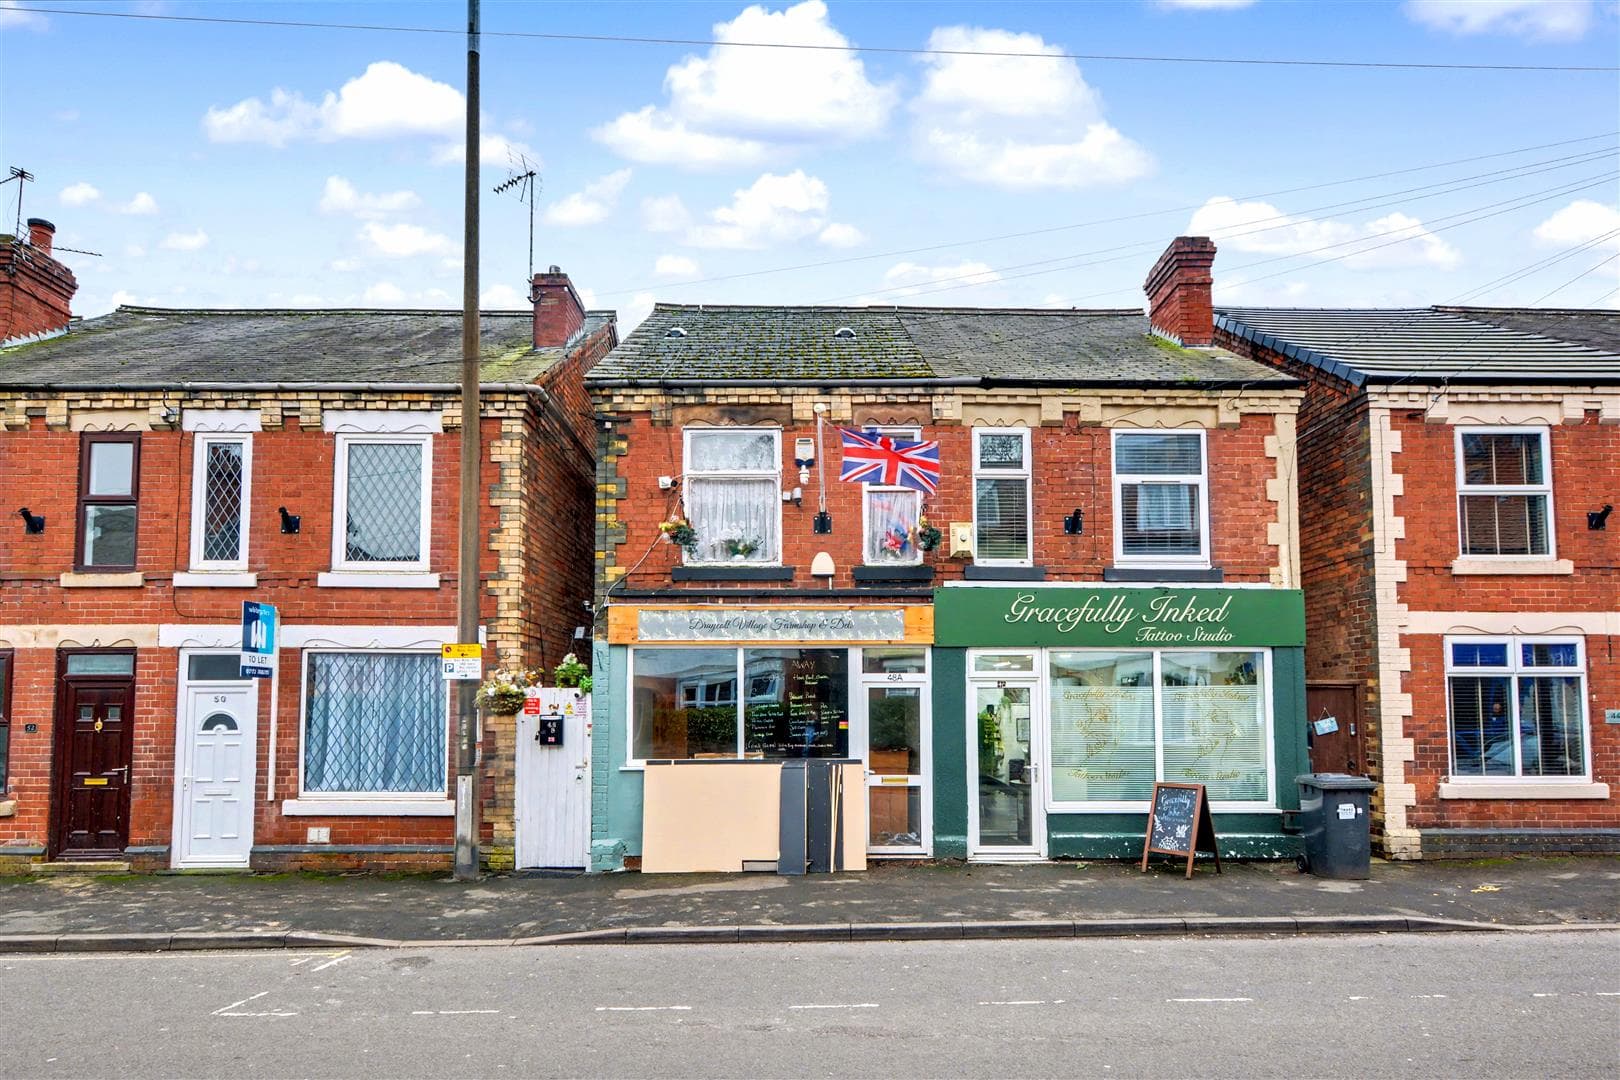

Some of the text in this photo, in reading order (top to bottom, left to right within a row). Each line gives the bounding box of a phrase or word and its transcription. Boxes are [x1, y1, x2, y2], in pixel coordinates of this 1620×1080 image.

[1004, 592, 1233, 633] Gracefully Inked
[689, 618, 854, 633] Draycott Village Farmshop & Deli
[1135, 626, 1236, 642] Tattoo Studio
[257, 656, 267, 664] LET
[887, 673, 903, 681] 48A
[214, 695, 226, 703] 50
